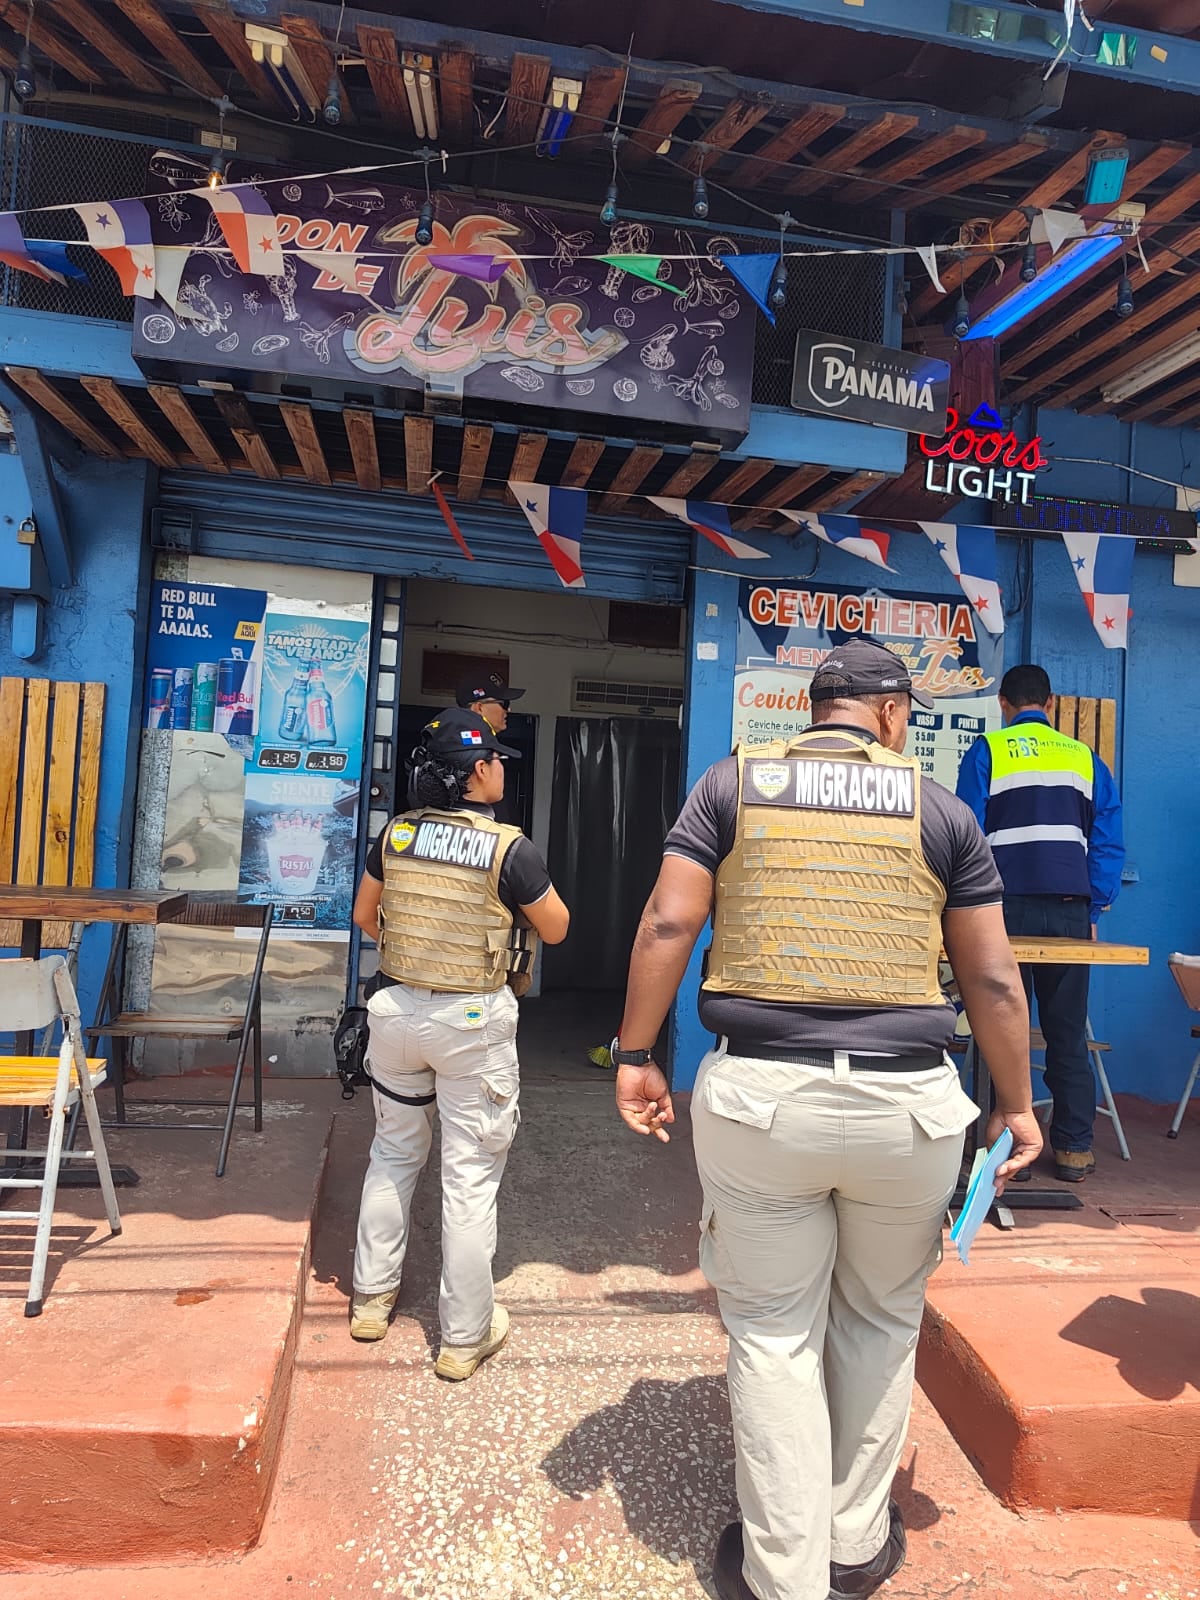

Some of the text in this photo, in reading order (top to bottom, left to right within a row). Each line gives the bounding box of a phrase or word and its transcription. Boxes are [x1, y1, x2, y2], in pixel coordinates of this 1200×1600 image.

[275, 214, 368, 253] DON
[355, 262, 624, 374] Luis
[822, 356, 935, 412] PANAMÁ
[919, 407, 1048, 471] Coors
[926, 459, 1036, 505] LIGHT
[161, 588, 216, 606] RED BULL
[160, 605, 195, 620] TE DA
[749, 587, 977, 643] CEVICHERIA
[158, 621, 213, 639] AAALAS.
[286, 647, 345, 661] VERANO
[311, 639, 357, 652] READY
[776, 645, 836, 668] MEN
[911, 641, 995, 692] Luis
[237, 692, 254, 705] Bul
[738, 681, 810, 712] Cevich
[747, 719, 781, 731] Ceviche
[782, 722, 794, 732] de
[795, 723, 804, 732] la
[916, 714, 979, 730] VASO PINTA
[920, 732, 936, 742] 5.00
[963, 735, 976, 745] 14.0
[920, 747, 935, 758] 3.50
[272, 781, 330, 797] SIENTE
[795, 761, 912, 813] MIGRACION
[414, 822, 497, 868] MIGRACION
